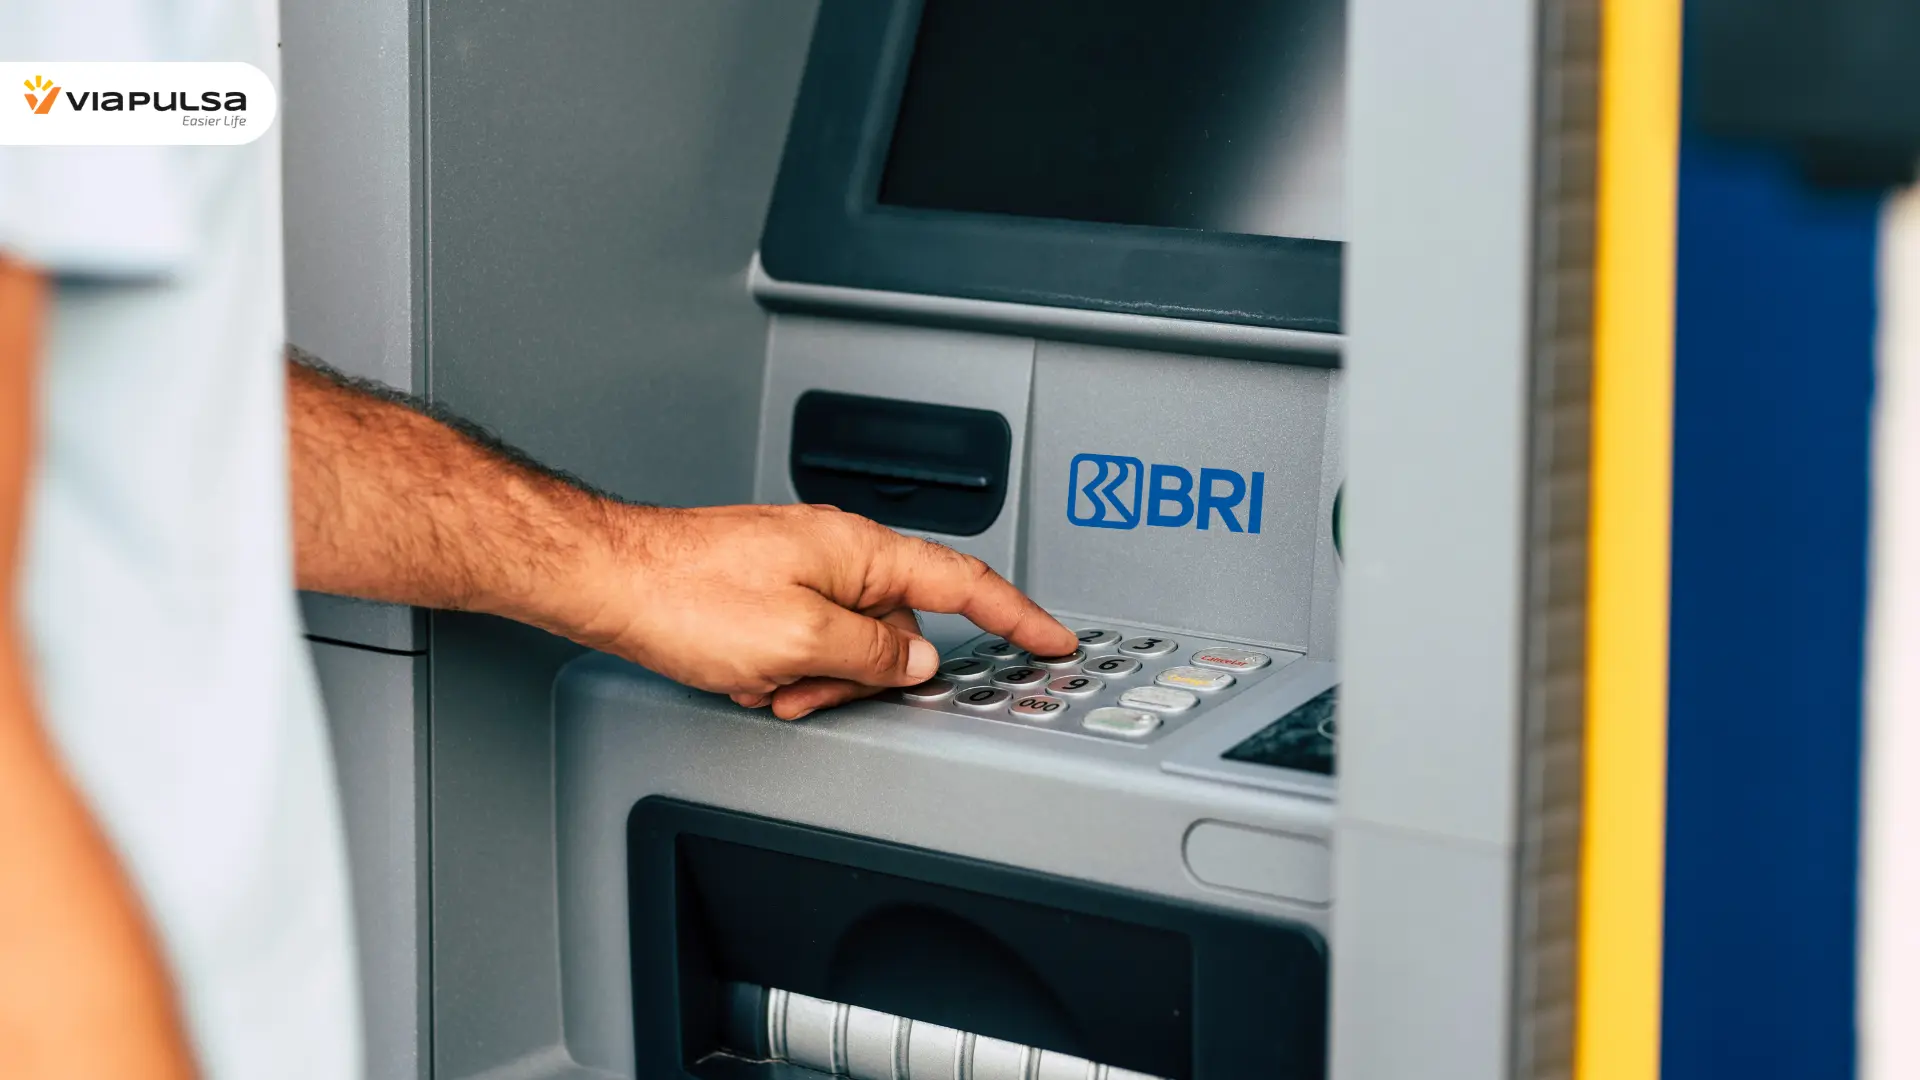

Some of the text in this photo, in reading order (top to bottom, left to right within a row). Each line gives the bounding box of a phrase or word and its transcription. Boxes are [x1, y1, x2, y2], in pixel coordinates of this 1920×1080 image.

[1146, 464, 1265, 534] BRI
[1078, 631, 1104, 643] 2
[1132, 638, 1163, 650] 3
[951, 660, 981, 672] 7
[1098, 659, 1127, 671] 6
[1200, 655, 1249, 667] Cancelar
[1006, 670, 1034, 682] 8
[1061, 678, 1089, 690] 9
[969, 690, 995, 702] 0
[1019, 698, 1060, 712] 000
